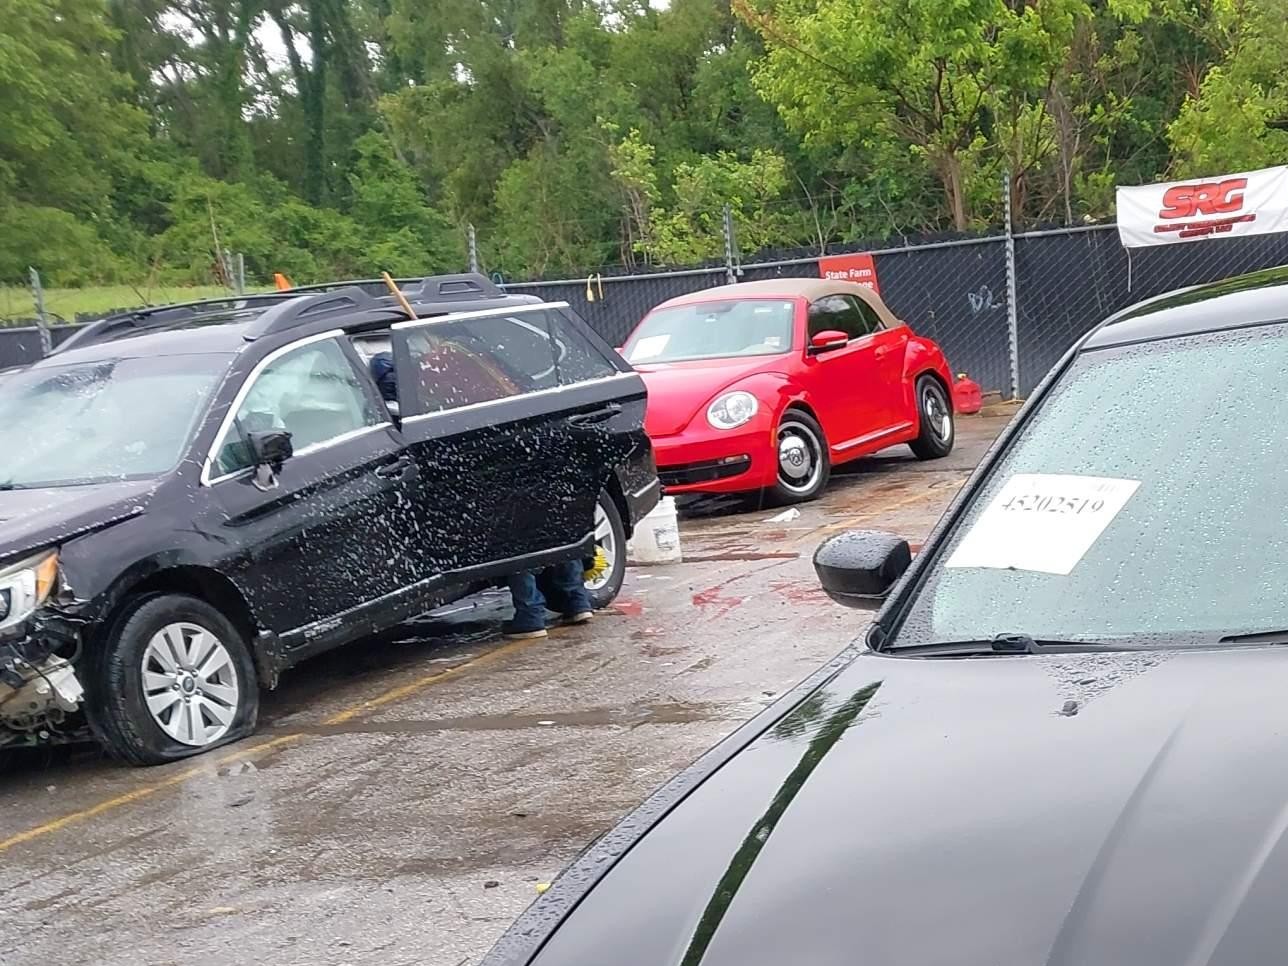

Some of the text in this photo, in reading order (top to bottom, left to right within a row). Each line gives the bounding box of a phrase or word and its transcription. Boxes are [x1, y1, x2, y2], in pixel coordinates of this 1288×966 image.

[1158, 177, 1249, 220] SRG
[825, 268, 872, 280] State Farm
[1001, 494, 1106, 515] 45202519
